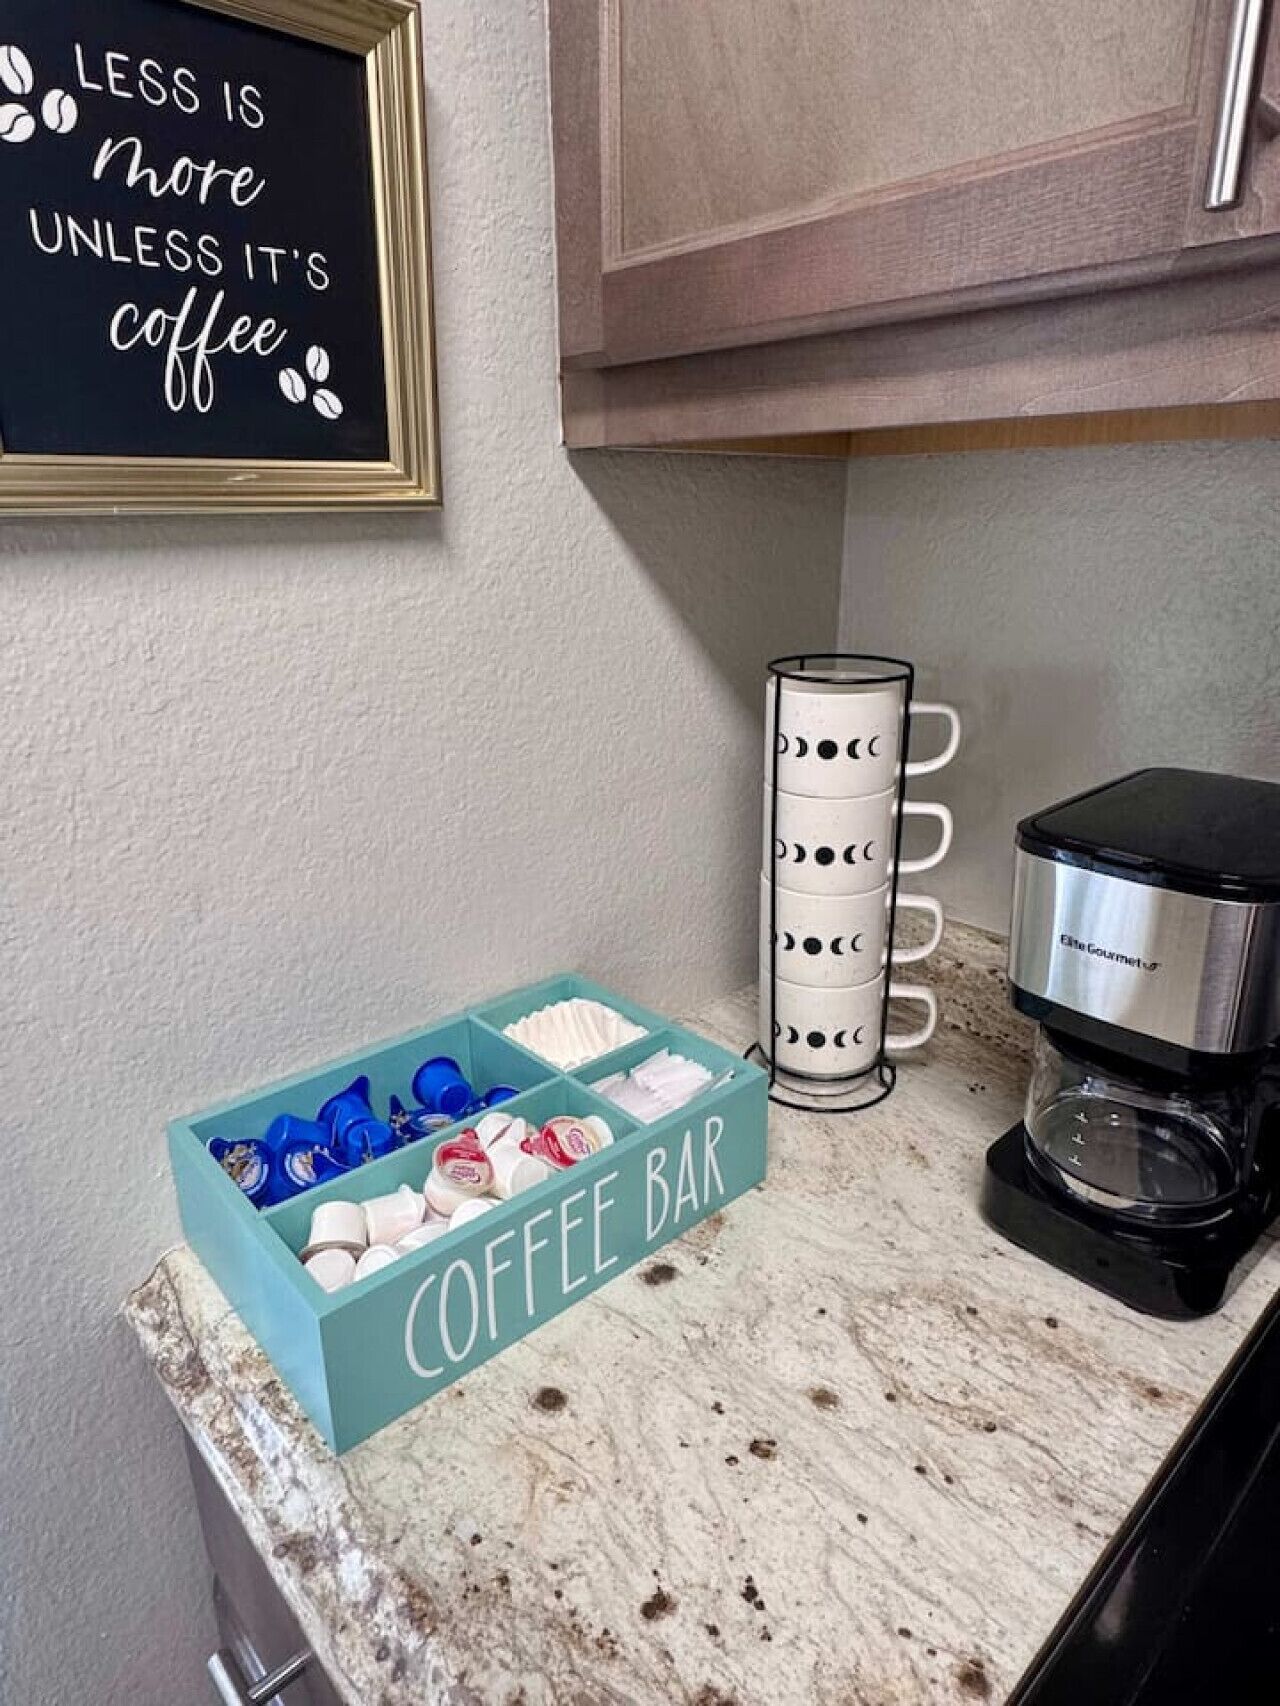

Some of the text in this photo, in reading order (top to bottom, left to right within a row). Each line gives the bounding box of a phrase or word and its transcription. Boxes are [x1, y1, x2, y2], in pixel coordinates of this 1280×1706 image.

[75, 43, 265, 129] LESS IS
[93, 136, 266, 207] more
[29, 208, 330, 290] UNLESS IT'S
[110, 286, 288, 413] coffee
[1060, 934, 1141, 968] Elite Gourmet
[404, 1115, 725, 1378] COFFEE BAR
